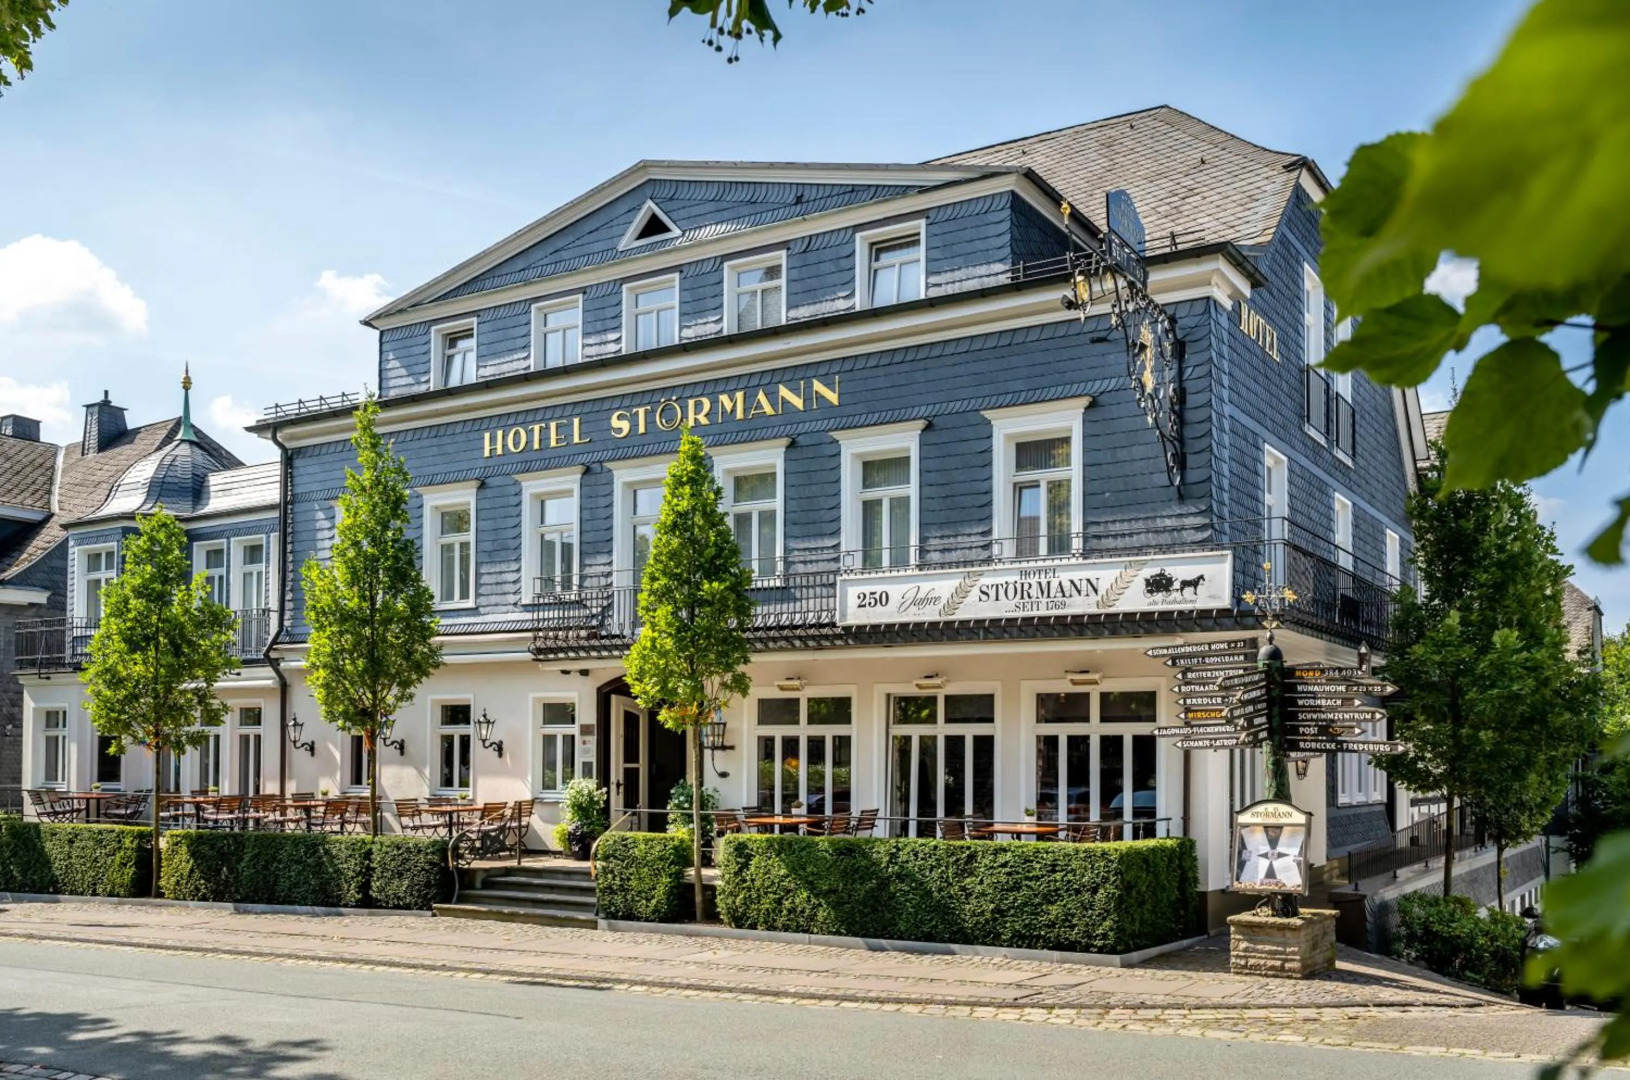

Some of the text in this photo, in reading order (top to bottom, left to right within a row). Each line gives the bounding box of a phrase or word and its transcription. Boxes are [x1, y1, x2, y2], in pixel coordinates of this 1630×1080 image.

[1239, 299, 1280, 362] HOTEL
[483, 376, 839, 458] HOTEL STÖRMANN
[1019, 568, 1060, 581] HOTEL
[978, 577, 1101, 603] STÖRMANN
[856, 585, 943, 614] 250 Jahre
[1045, 600, 1067, 612] 1769
[1181, 684, 1219, 692] ROTHAARG
[1296, 698, 1342, 706] WORMBACH
[1187, 711, 1222, 719] HIRSCHG
[1297, 712, 1372, 720] SCHWIMMZENTRUM
[1298, 726, 1319, 735] POST
[1299, 741, 1337, 750] ROBECKE
[1342, 742, 1391, 752] FREDEBURG
